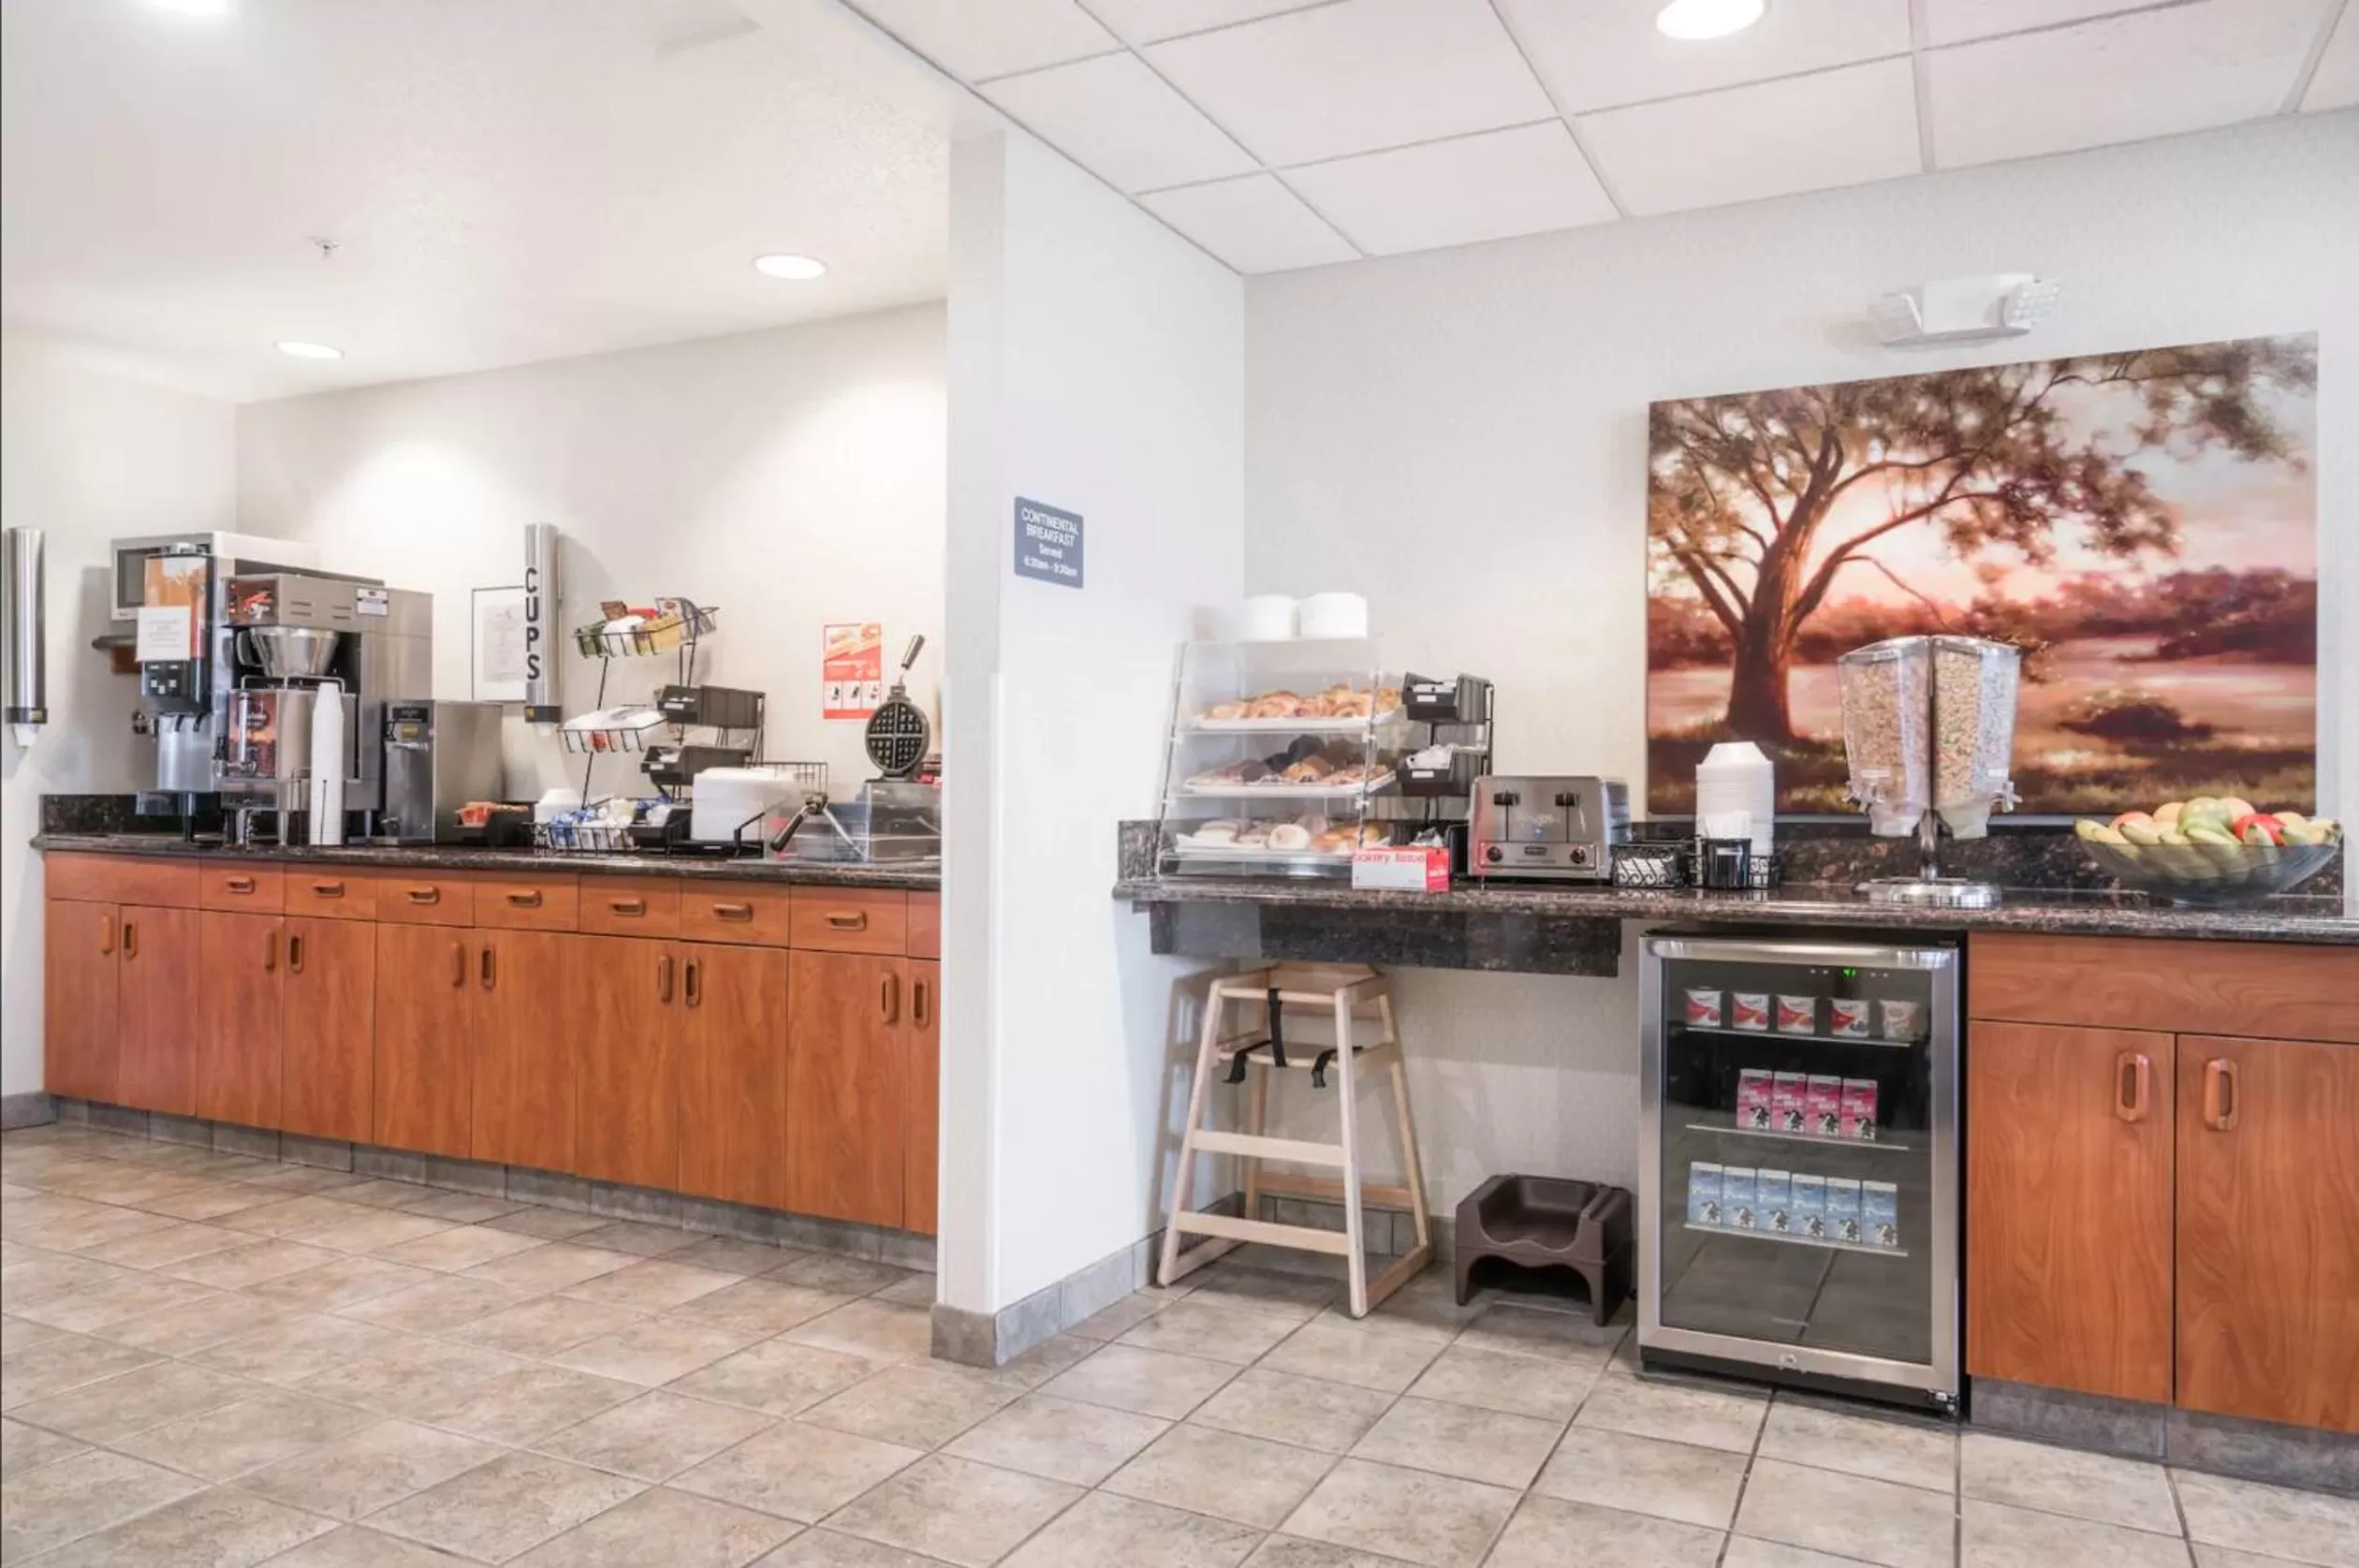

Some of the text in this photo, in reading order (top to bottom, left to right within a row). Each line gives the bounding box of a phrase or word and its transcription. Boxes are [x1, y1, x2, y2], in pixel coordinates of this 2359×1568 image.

[1021, 506, 1078, 535] CONTINENTAL
[1026, 522, 1075, 548] BREAKFAST
[526, 566, 540, 681] CUPS
